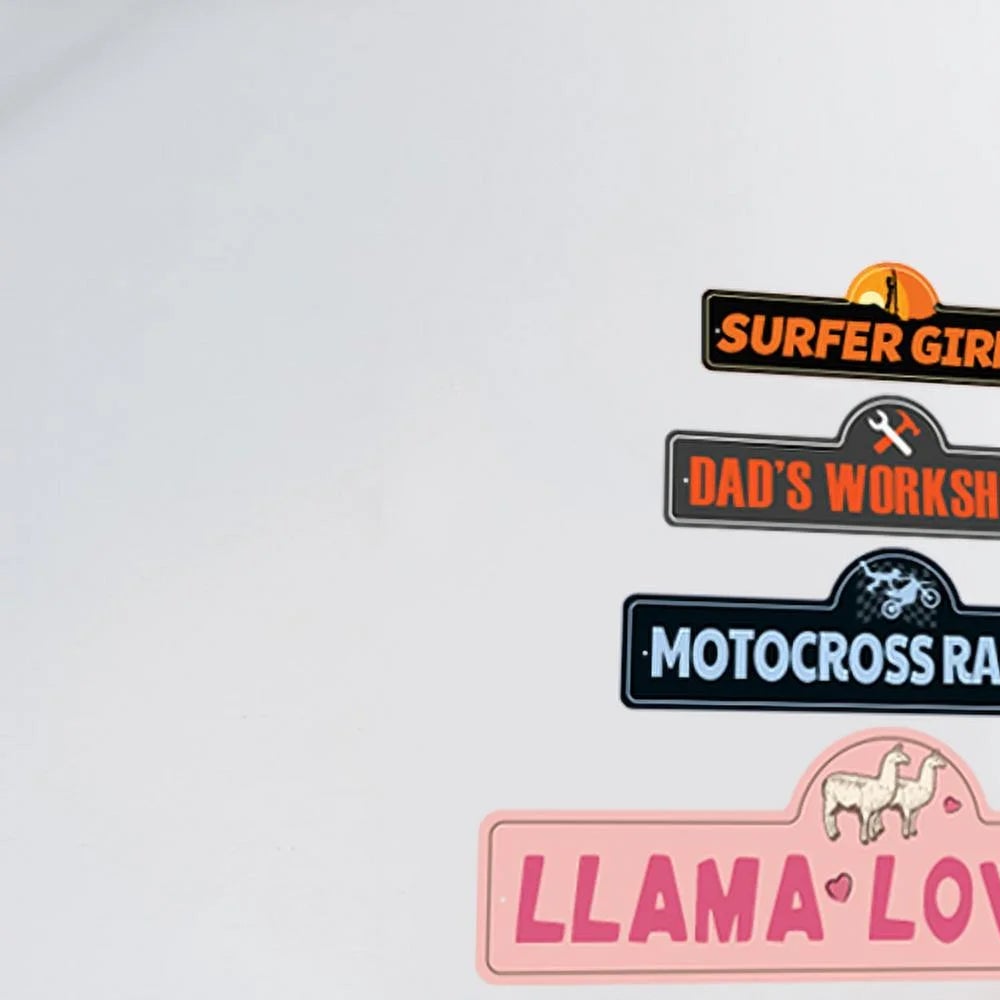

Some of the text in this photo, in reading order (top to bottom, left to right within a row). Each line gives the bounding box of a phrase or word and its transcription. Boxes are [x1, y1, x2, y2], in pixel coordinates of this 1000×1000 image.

[716, 312, 904, 363] SURFER
[689, 455, 813, 512] DAD'S
[650, 625, 935, 686] MOTOCROSS
[515, 854, 824, 945] LLAMA
